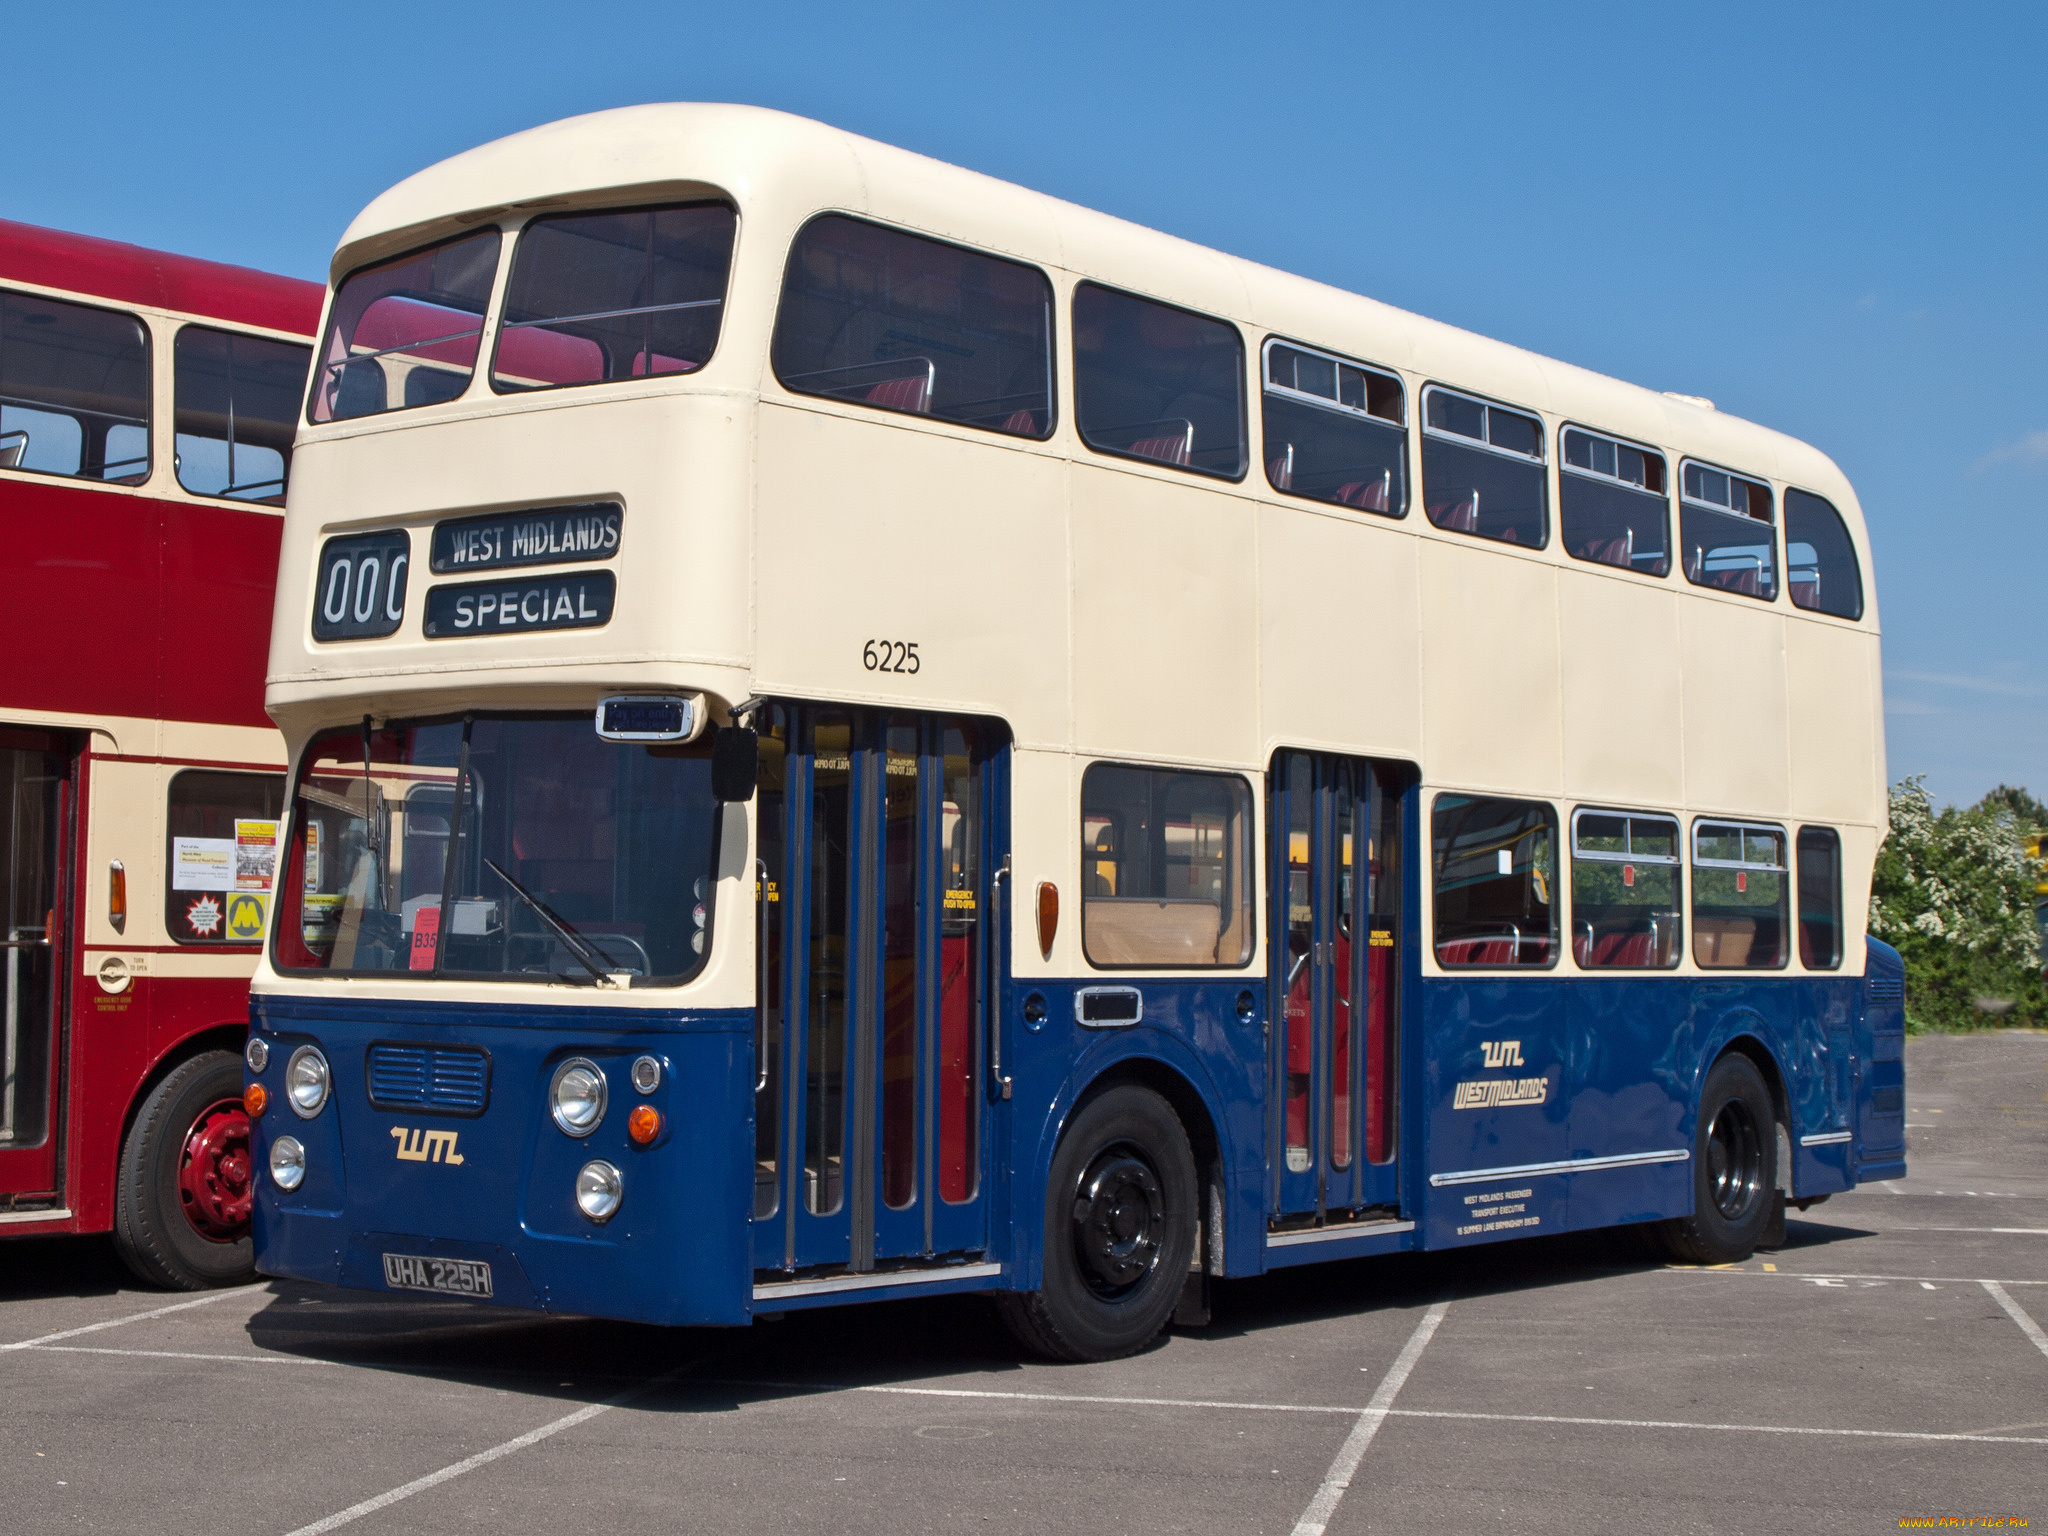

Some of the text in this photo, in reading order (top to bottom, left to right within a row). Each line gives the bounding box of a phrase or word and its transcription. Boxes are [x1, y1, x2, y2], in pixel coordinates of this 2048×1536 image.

[451, 513, 619, 564] WEST MIDLANDS
[453, 585, 598, 629] SPECIAL
[863, 639, 920, 675] 6225
[414, 932, 437, 948] B35
[1464, 1195, 1478, 1205] WEST
[1479, 1192, 1505, 1203] MIDLANDS
[1471, 1203, 1526, 1218] TRANSPORT EXECUTIVE
[1483, 1222, 1495, 1232] LANE
[386, 1256, 489, 1293] UHA 225H
